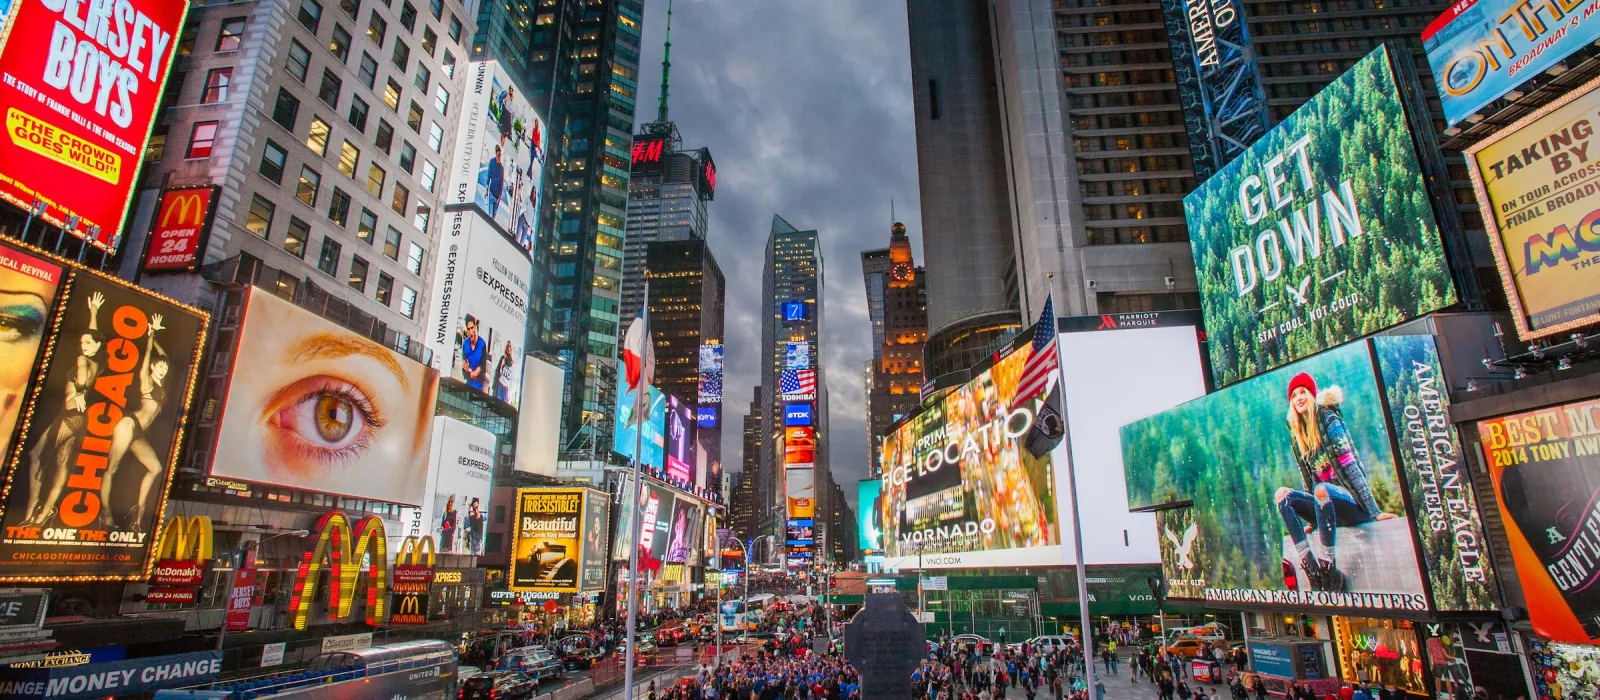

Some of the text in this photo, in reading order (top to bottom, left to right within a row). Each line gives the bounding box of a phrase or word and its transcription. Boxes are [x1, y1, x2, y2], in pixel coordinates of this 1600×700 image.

[1508, 15, 1580, 78] BROADWAY'S
[42, 20, 139, 129] BOYS
[1442, 28, 1517, 96] ON
[3, 72, 137, 155] THE STORY OF FRANKIE VALLI & THE FOUR SEASONS
[14, 126, 64, 155] GOES
[59, 133, 115, 166] CROWD
[1489, 118, 1594, 180] TAKING
[1550, 140, 1589, 175] BY
[458, 183, 467, 203] EXP
[1238, 134, 1314, 226] GET
[1501, 198, 1517, 213] ON
[1518, 183, 1551, 204] TOUR
[1505, 206, 1545, 230] FINAL
[160, 228, 196, 239] OPEN
[160, 239, 189, 254] 24
[1230, 179, 1363, 297] DOWN
[20, 263, 53, 282] REVIVAL
[149, 254, 193, 265] HOURS
[435, 244, 458, 345] @EXPRESSRUNWAY
[1257, 292, 1363, 343] STAY COOL. NOT COLD.
[59, 305, 148, 528] CHICAGO
[917, 421, 954, 451] PRIME
[1485, 411, 1558, 450] BEST
[1493, 446, 1529, 467] 2014
[1529, 441, 1571, 462] TONY
[1403, 405, 1448, 532] OUTFITTERS
[1411, 359, 1487, 584] AMERICAN EAGLE
[6, 526, 147, 543] THE ONE THE ONLY
[523, 517, 577, 531] Beautiful
[558, 531, 577, 539] Musical
[902, 517, 996, 546] VORNADO
[1545, 525, 1567, 545] A
[153, 565, 202, 577] McDonald's
[926, 556, 962, 566] VNO.COM
[434, 571, 462, 583] XPRESS
[231, 584, 255, 599] JERSEY
[233, 597, 251, 609] BOYS
[520, 592, 560, 600] LUGGAGE
[1206, 588, 1427, 610] AMERICAN EAGLE OUTFITTERS
[10, 655, 91, 669] MONEY EXCHANGE
[409, 670, 434, 681] UNITED
[45, 658, 223, 698] MONEY CHANGE
